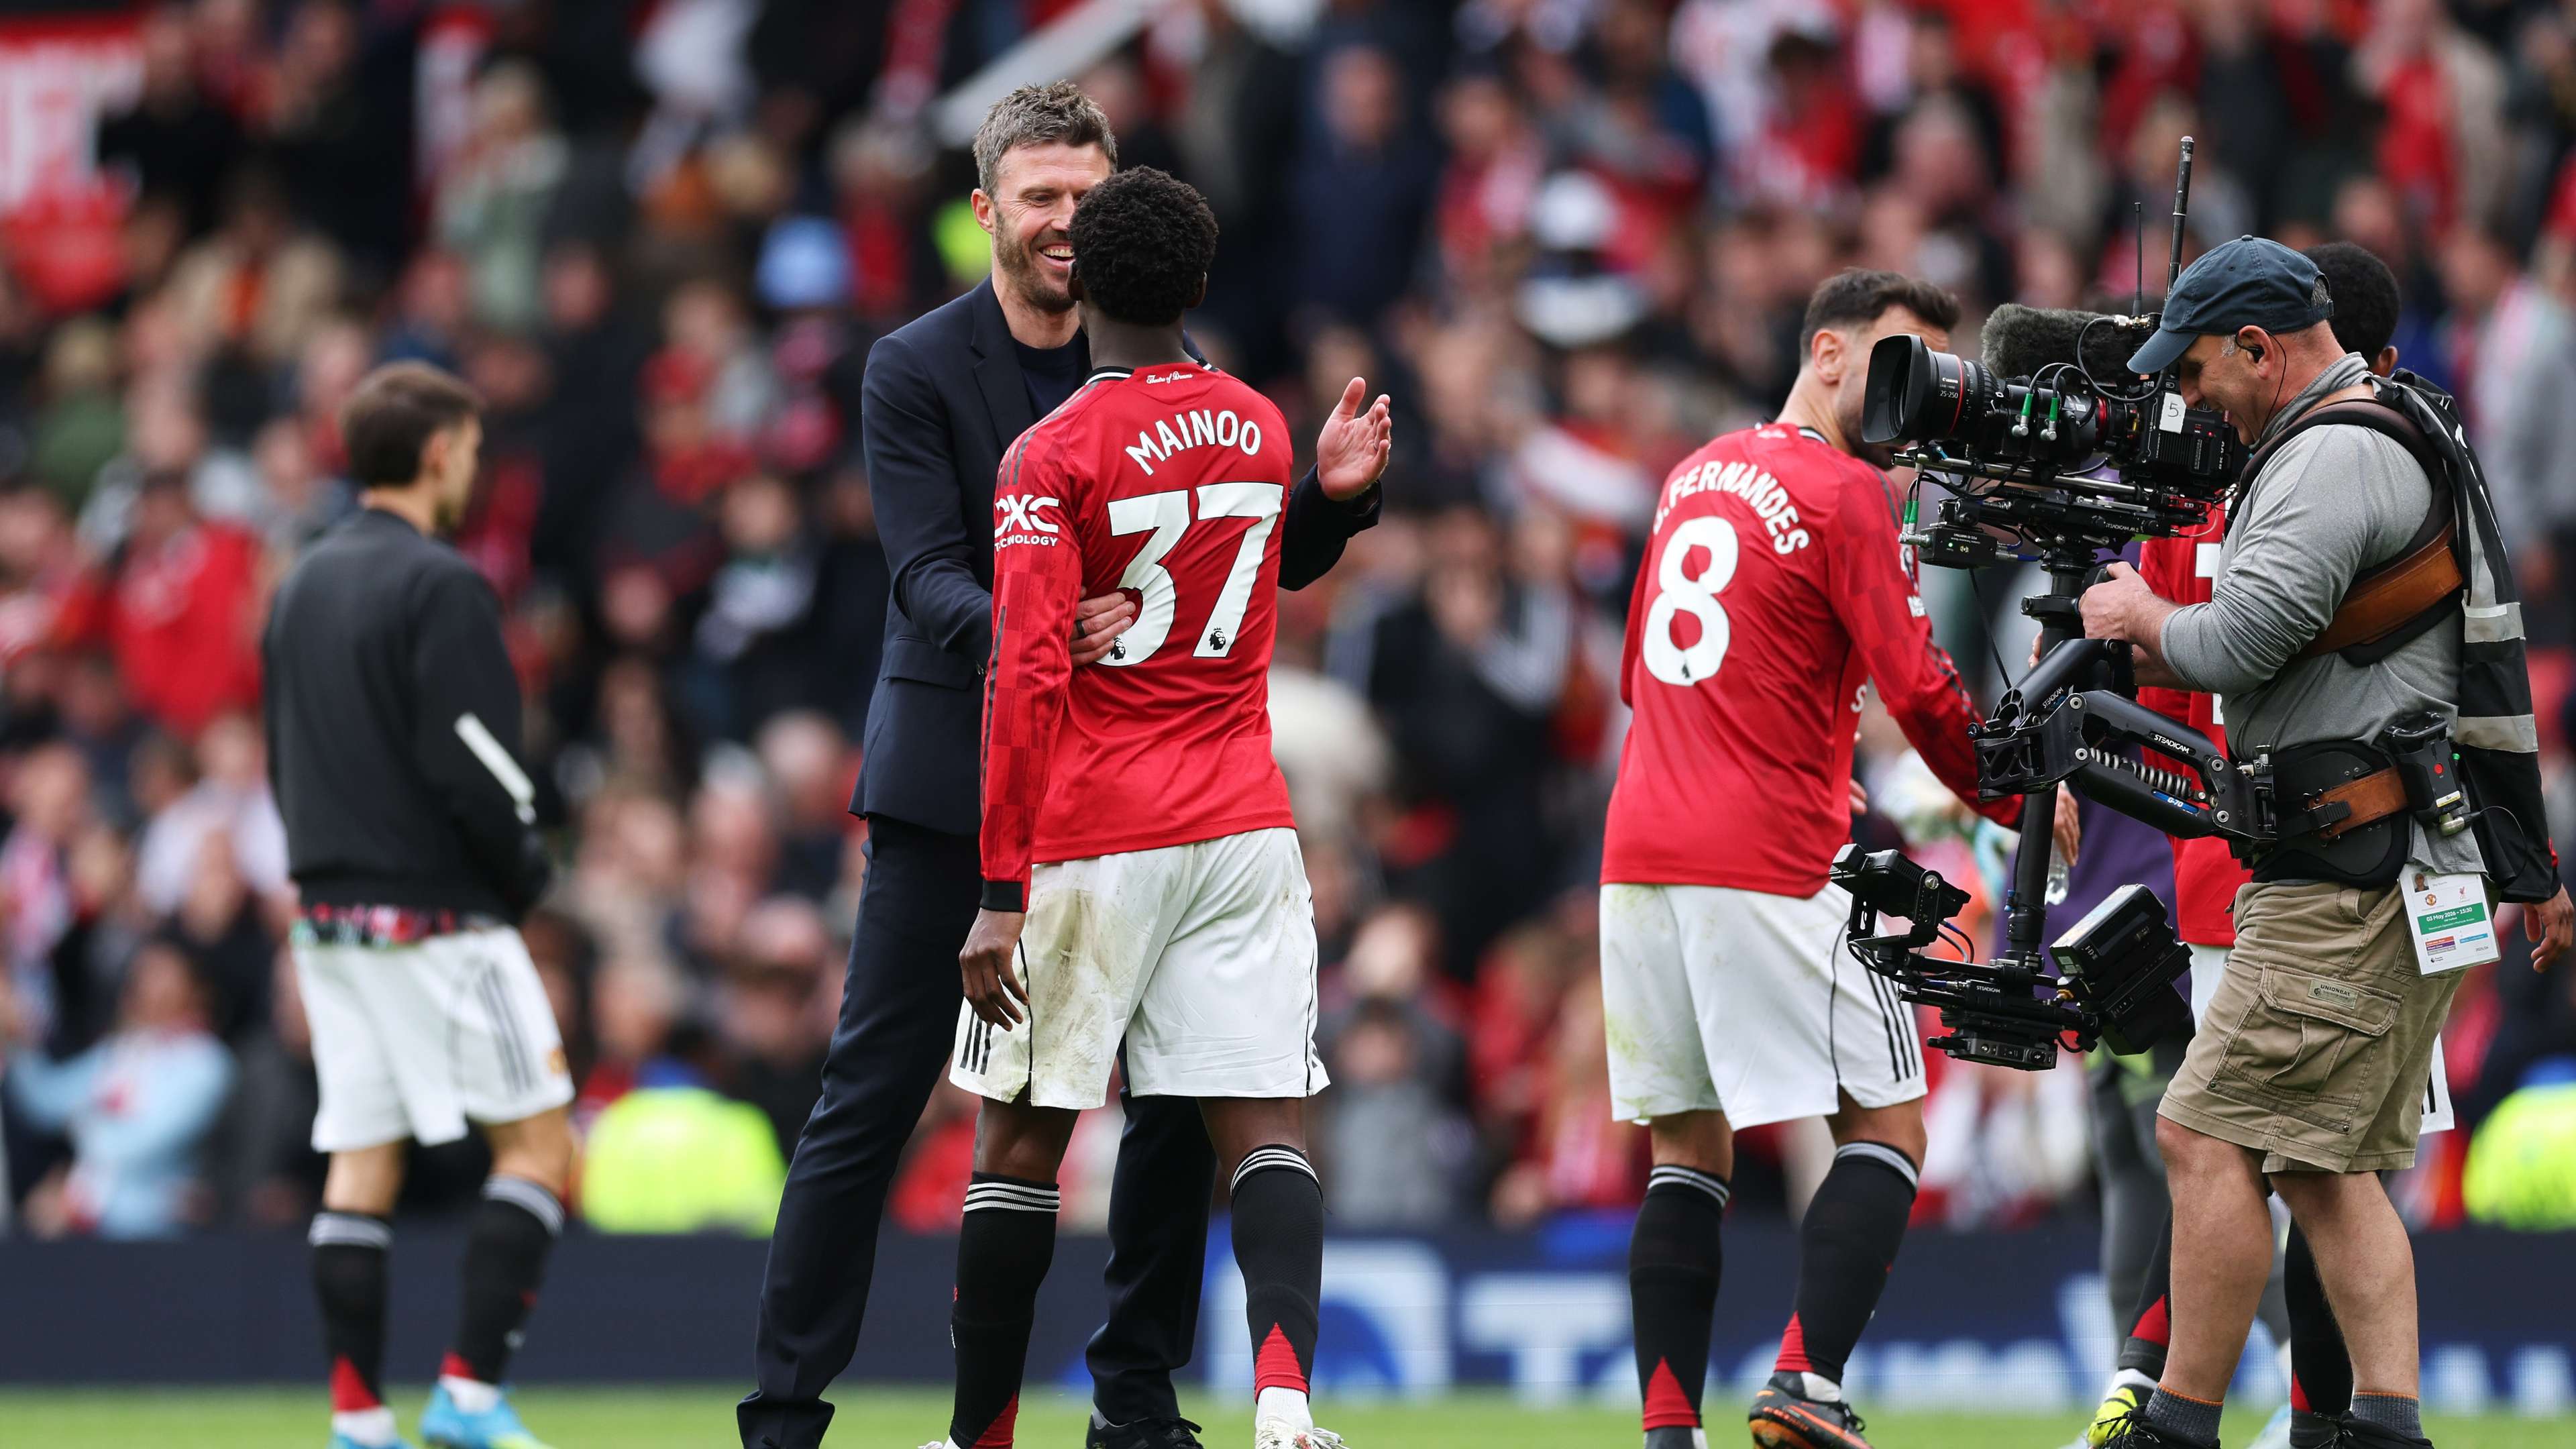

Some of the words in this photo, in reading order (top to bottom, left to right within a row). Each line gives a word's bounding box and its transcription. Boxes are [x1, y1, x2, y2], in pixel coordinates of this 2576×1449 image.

[1126, 410, 1261, 476] MAINOO
[1096, 482, 1284, 667] 37
[1643, 515, 1739, 687] 8
[2154, 735, 2190, 753] STEADICAM
[2167, 797, 2184, 807] G-70
